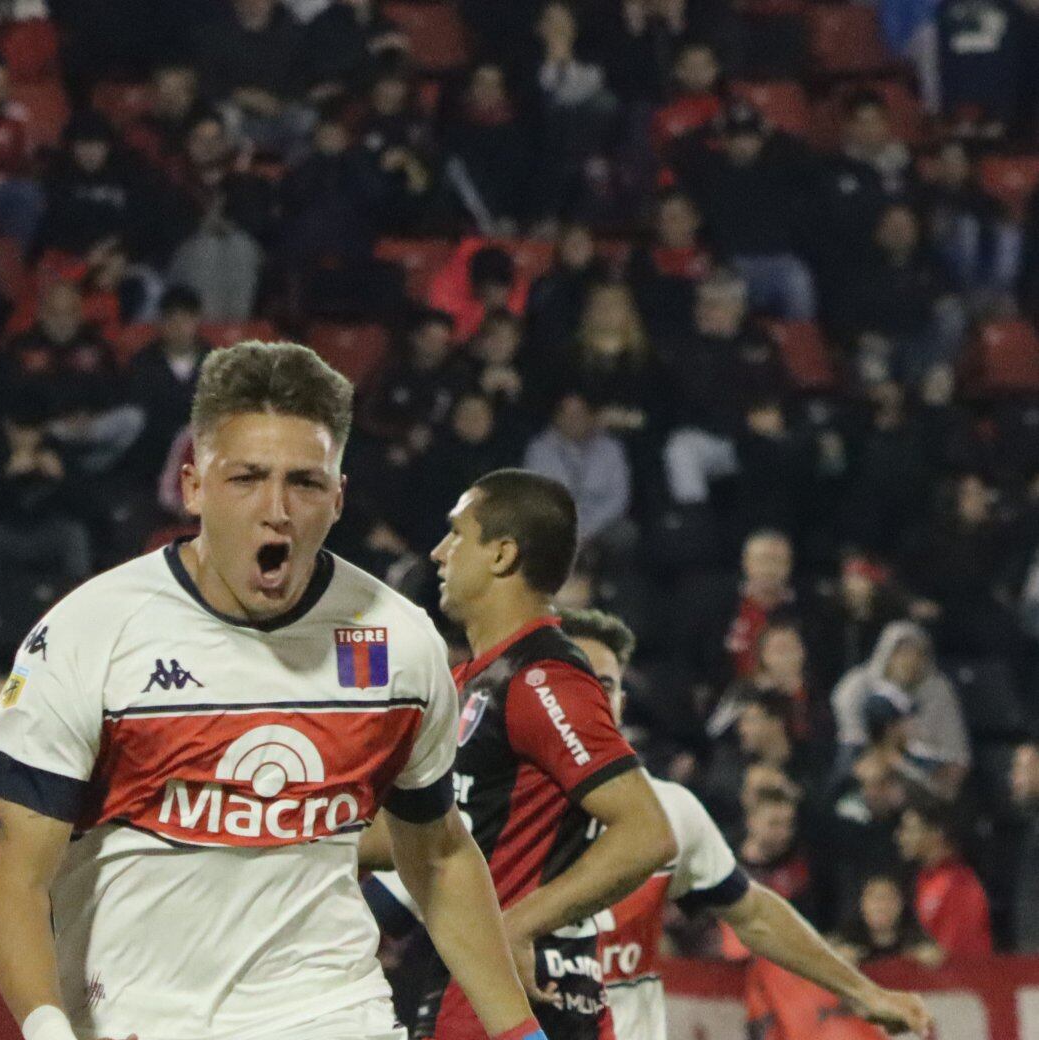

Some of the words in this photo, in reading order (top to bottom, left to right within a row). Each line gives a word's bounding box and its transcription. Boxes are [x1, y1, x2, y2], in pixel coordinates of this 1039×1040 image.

[337, 629, 385, 643] TIGRE
[534, 685, 592, 767] ADELANTE
[158, 780, 359, 839] Macro
